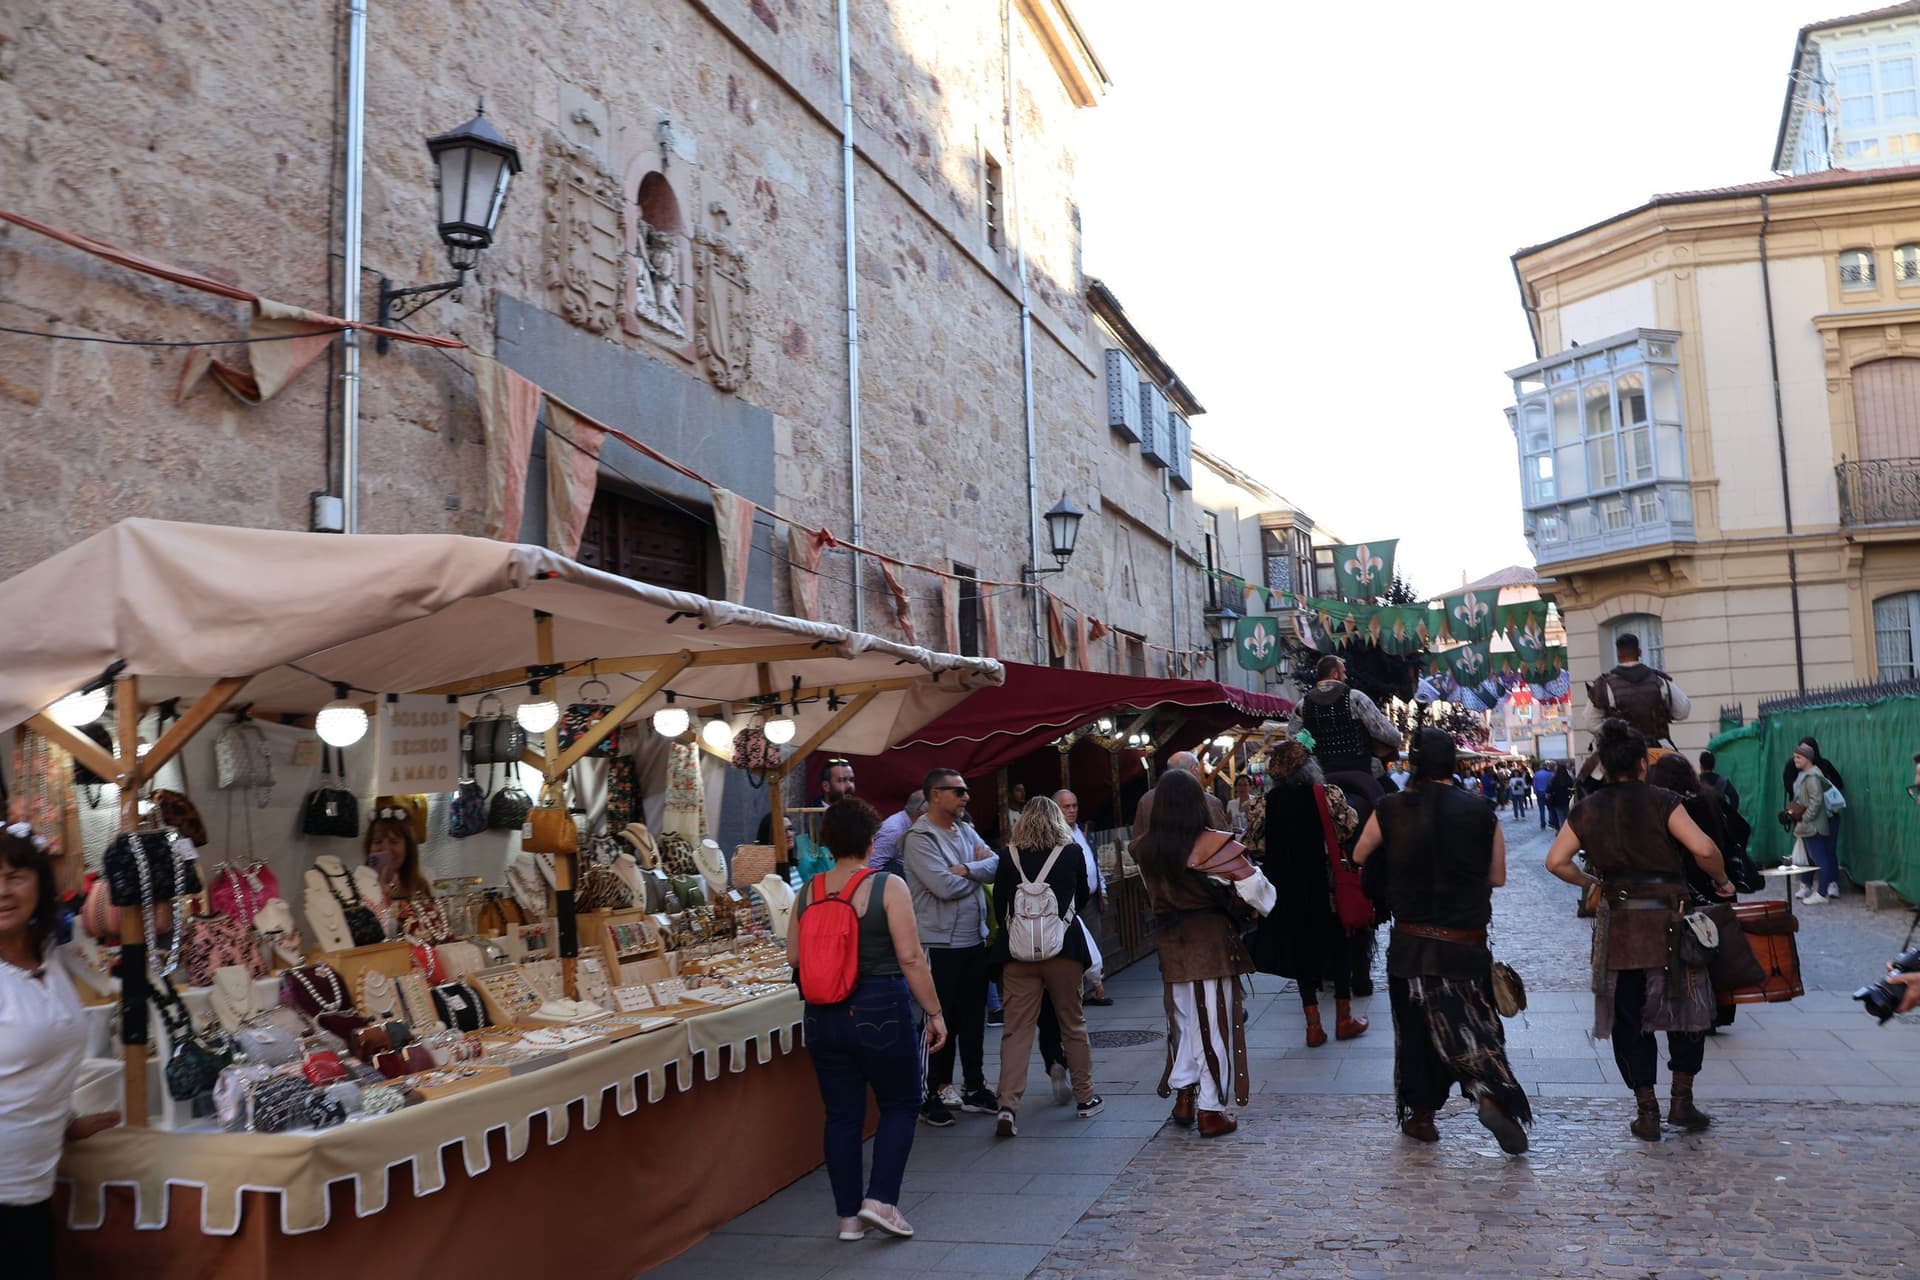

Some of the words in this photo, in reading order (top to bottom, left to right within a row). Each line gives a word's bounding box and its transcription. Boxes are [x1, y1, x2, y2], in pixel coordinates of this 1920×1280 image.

[391, 711, 449, 727] BOLSOS
[390, 767, 400, 782] A
[405, 765, 449, 780] MANO
